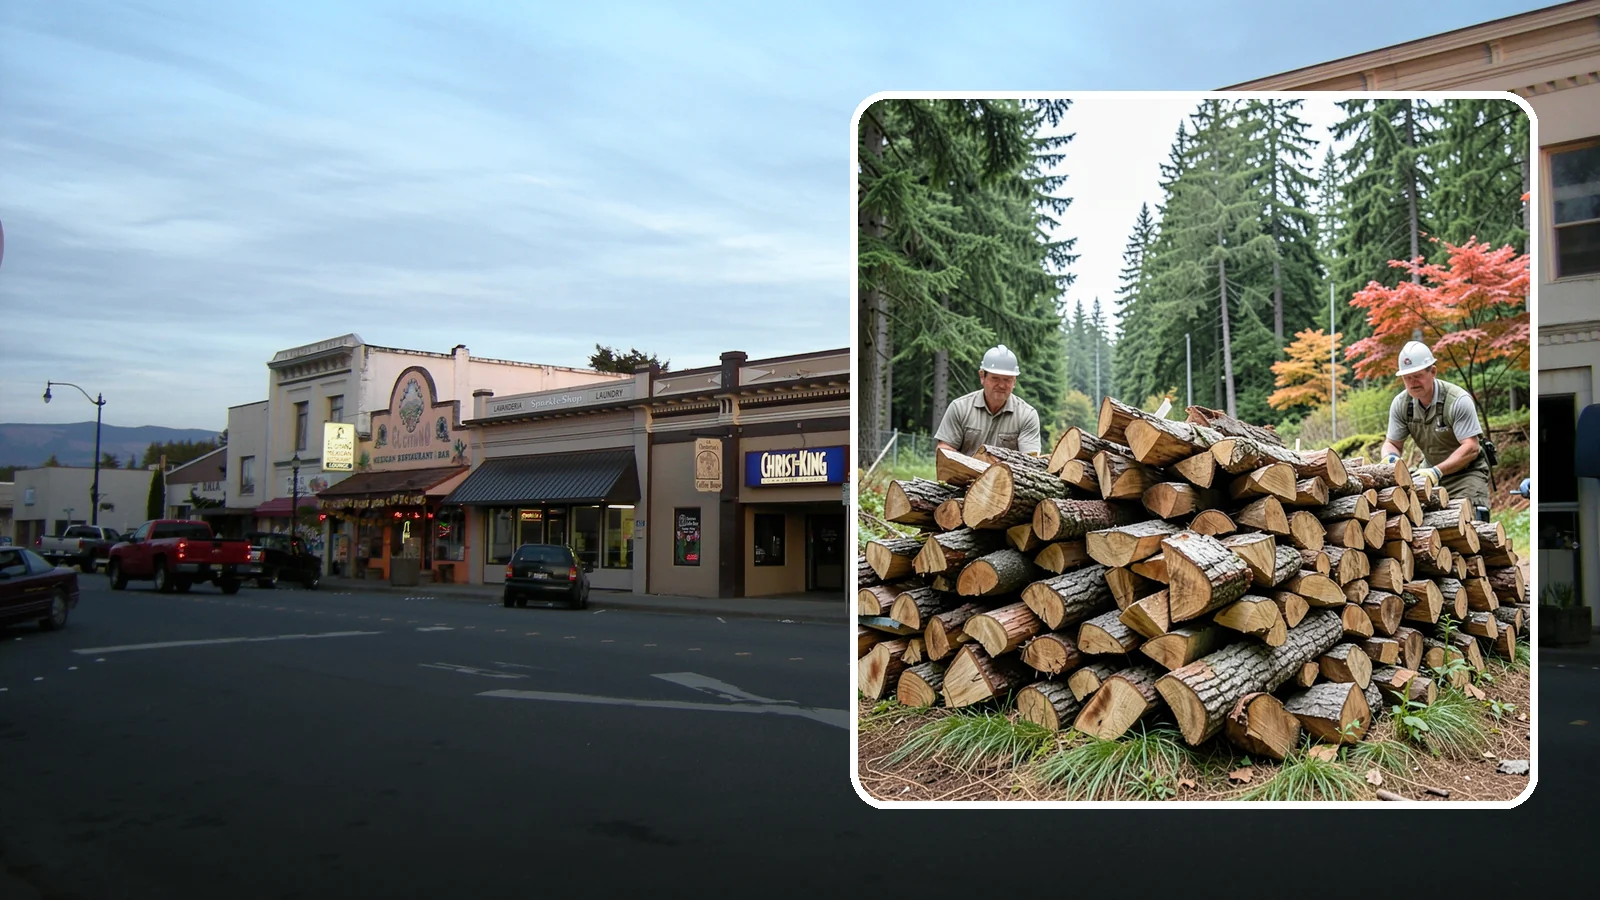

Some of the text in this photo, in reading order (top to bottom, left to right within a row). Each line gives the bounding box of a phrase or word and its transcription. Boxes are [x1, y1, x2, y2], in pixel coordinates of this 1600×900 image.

[595, 388, 624, 400] LAUNDRY
[493, 402, 523, 413] LAVANDERIA
[530, 394, 583, 409] Sparkle Shop
[373, 450, 450, 464] MEXICAN RESTAURANT BAR
[799, 450, 828, 476] KING
